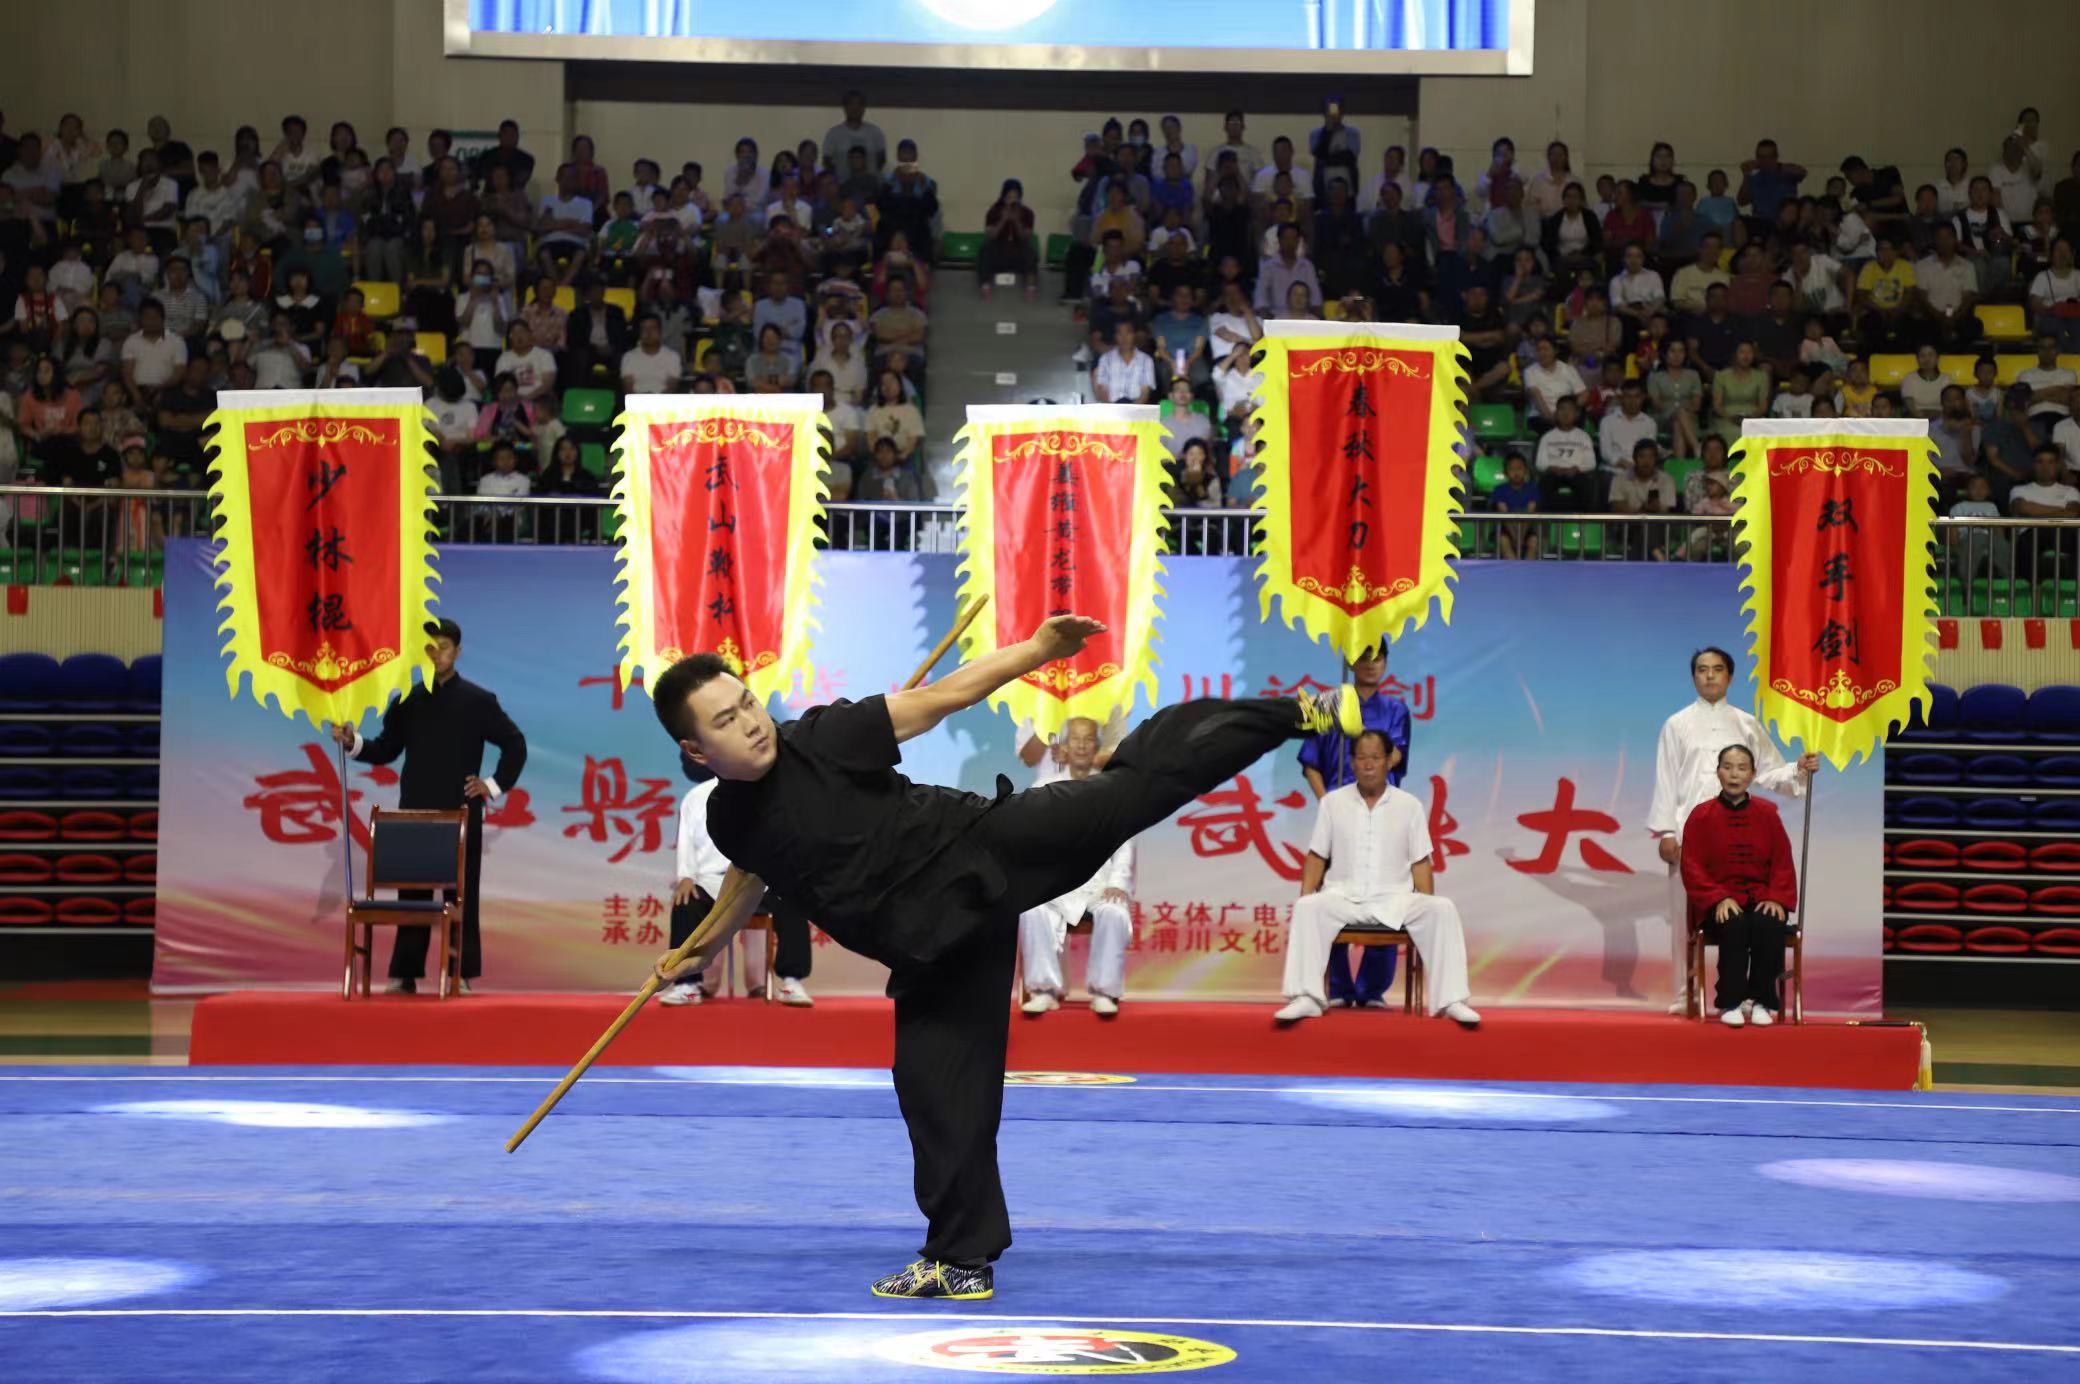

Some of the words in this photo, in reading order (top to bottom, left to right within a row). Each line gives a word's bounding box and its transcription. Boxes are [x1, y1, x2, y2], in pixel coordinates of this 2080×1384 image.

[305, 460, 354, 632] 少林棍
[1342, 381, 1377, 550] 春秋大刀
[1812, 497, 1860, 665] 双手剑
[602, 893, 664, 918] 主办
[1130, 901, 1294, 927] 县文体广电
[602, 919, 664, 945] 承办
[1126, 927, 1290, 954] 县渭川文化
